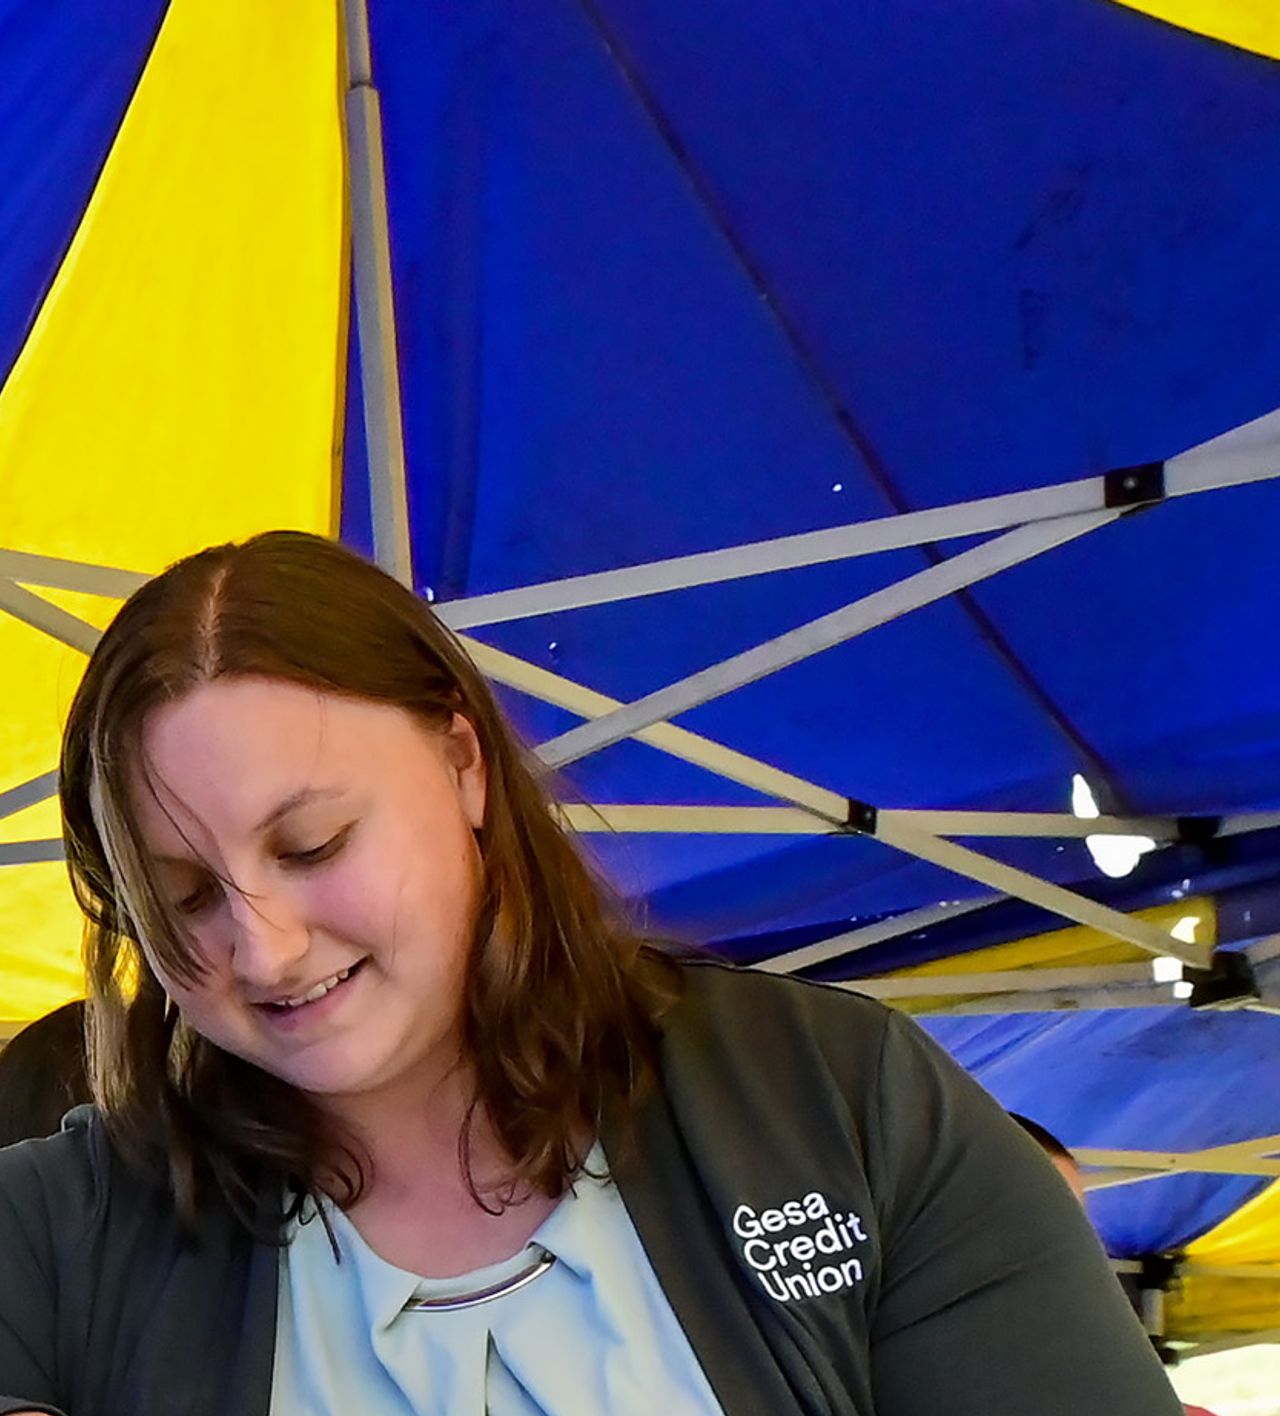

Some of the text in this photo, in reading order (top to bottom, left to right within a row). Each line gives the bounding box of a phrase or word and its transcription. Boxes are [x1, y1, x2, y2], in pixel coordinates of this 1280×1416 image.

[732, 1192, 829, 1239] Gesa
[743, 1212, 868, 1271] Credit
[757, 1258, 862, 1302] Union
